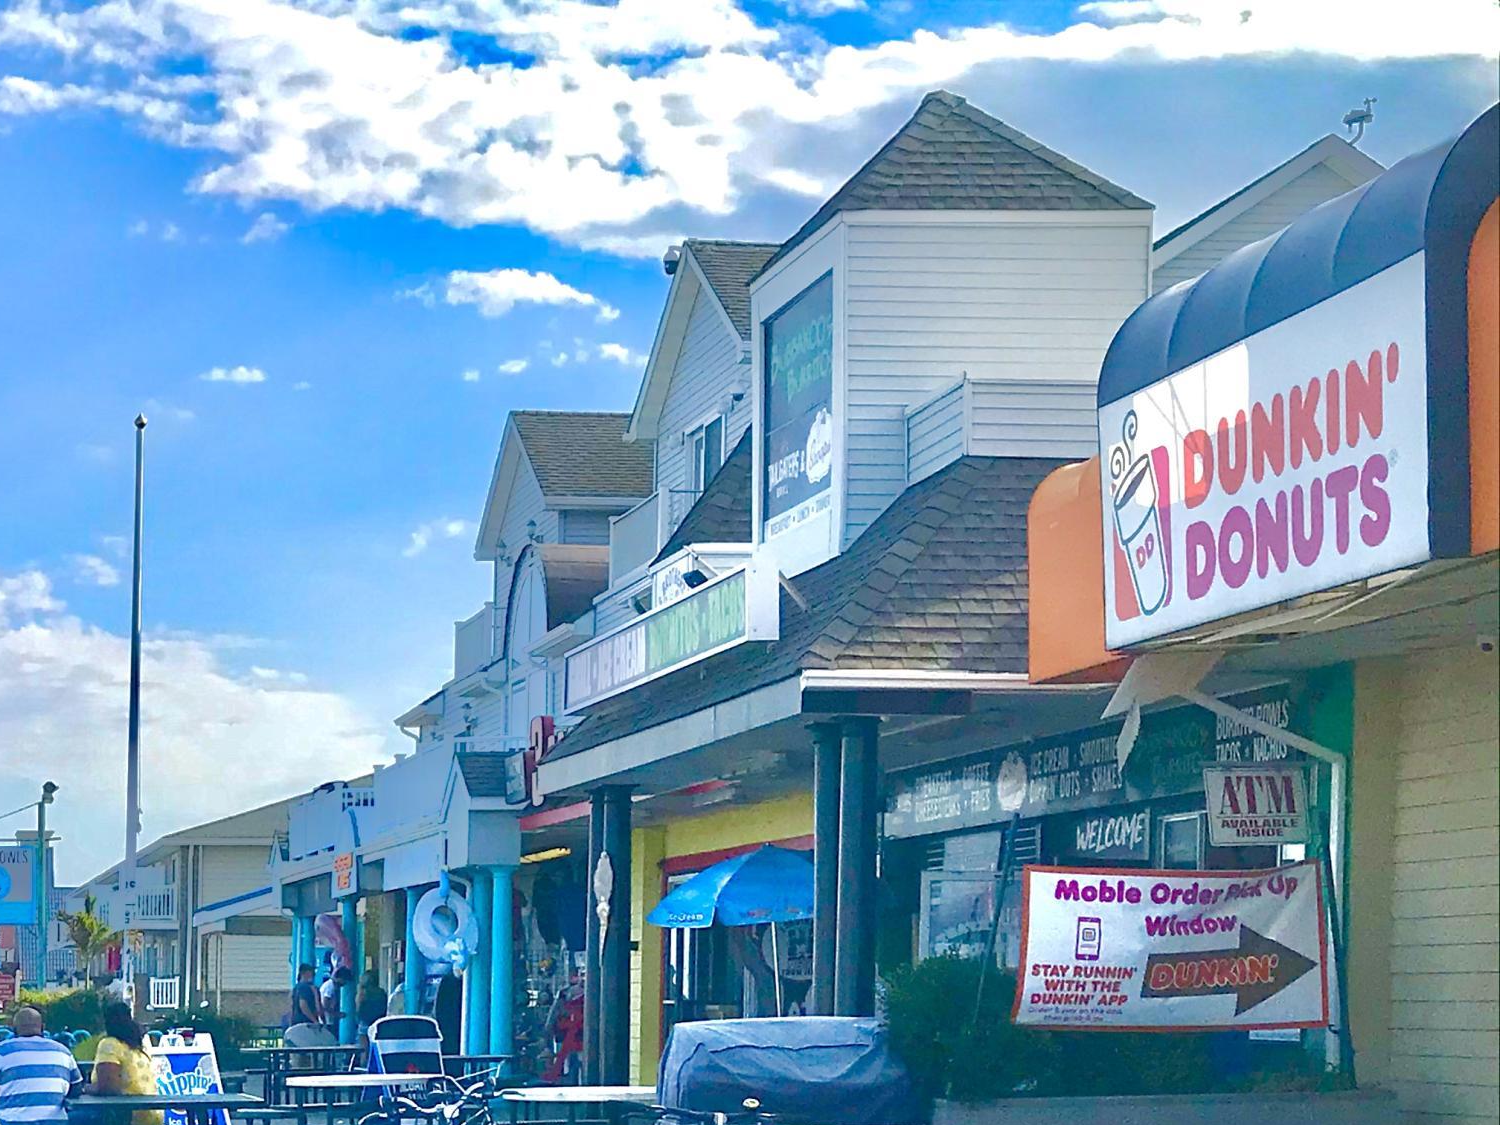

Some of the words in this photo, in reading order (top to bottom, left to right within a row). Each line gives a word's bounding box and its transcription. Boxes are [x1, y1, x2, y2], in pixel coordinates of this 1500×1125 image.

[1184, 342, 1399, 509] DUNKIN'
[1186, 453, 1391, 601] DONUTS
[1080, 736, 1118, 766] SMOOTHIE
[1220, 775, 1297, 815] ATM
[1077, 813, 1146, 853] WELCOME
[1221, 818, 1299, 828] AVAILABLE
[1236, 828, 1284, 837] INSIDE
[1150, 882, 1224, 905] Order
[1267, 875, 1298, 900] Up
[1145, 915, 1237, 937] Window
[1032, 964, 1070, 977] STAY
[1073, 965, 1138, 979] RUNNIN'
[1150, 954, 1278, 990] DUNKIN'
[1045, 979, 1086, 992] WITH
[1092, 981, 1121, 993] THE
[1030, 993, 1095, 1006] DUNKIN'
[1097, 994, 1128, 1006] APP
[168, 1117, 182, 1125] Ice
